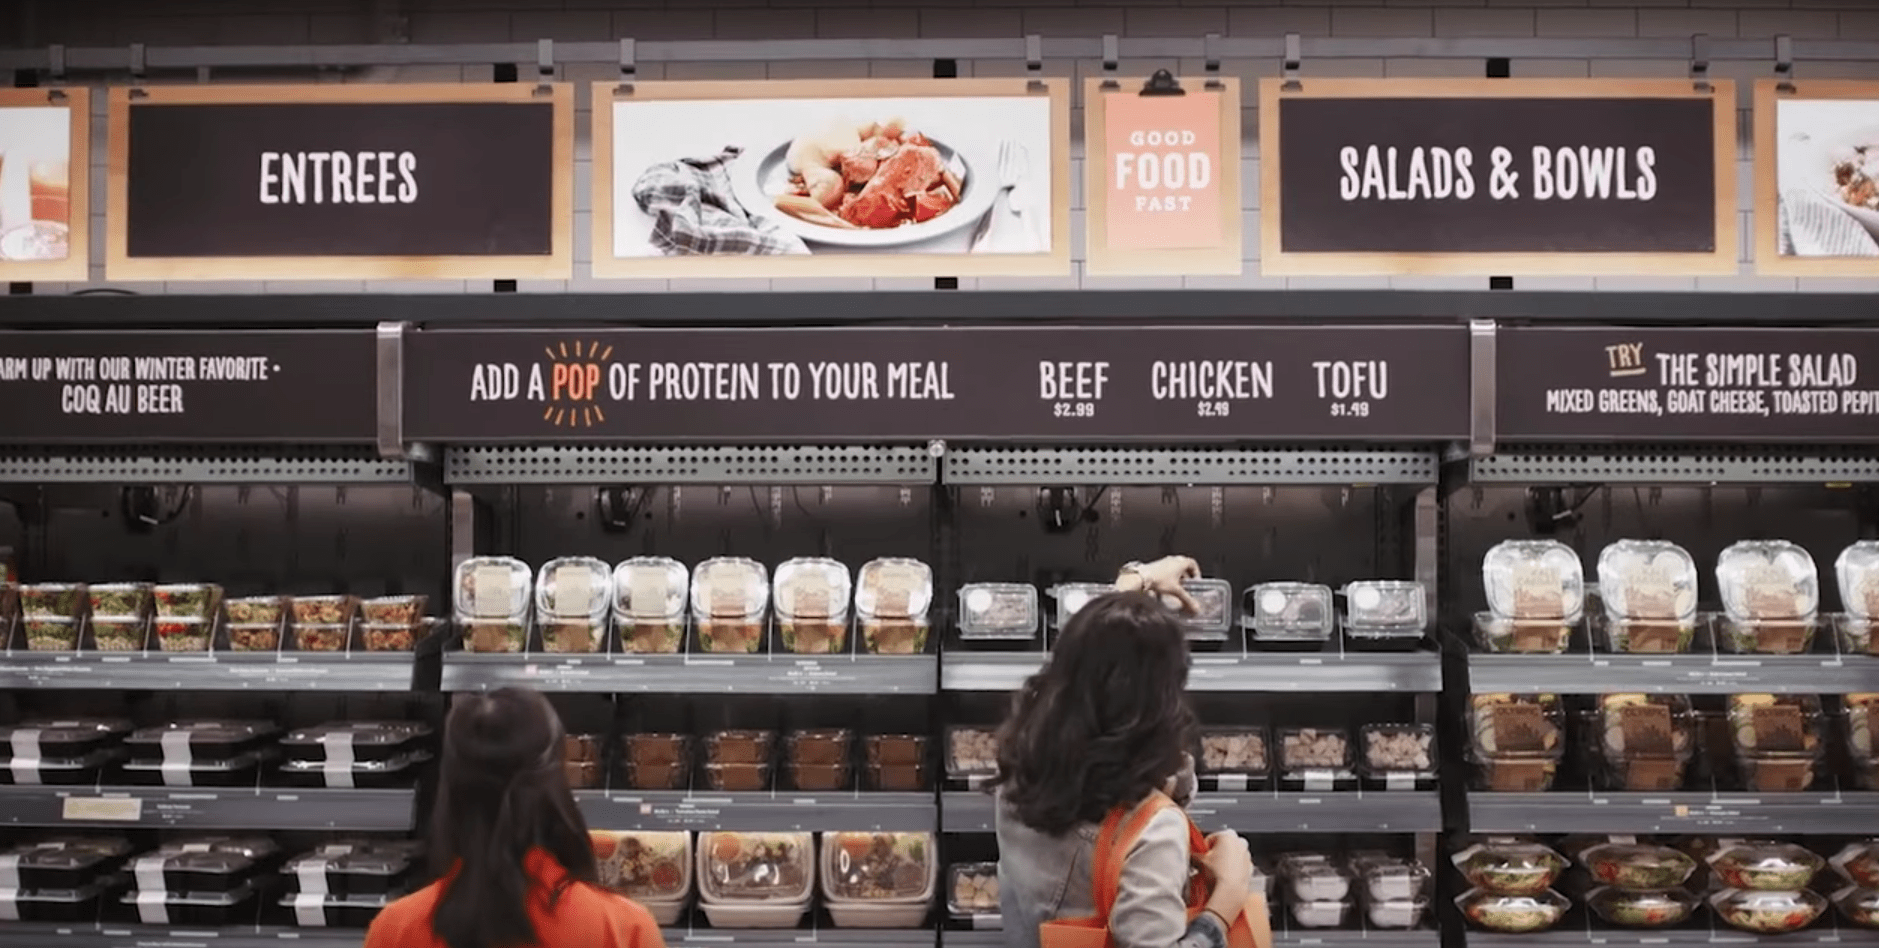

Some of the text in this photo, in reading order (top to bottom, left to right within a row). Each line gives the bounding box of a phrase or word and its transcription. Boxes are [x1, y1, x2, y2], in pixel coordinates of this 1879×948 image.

[1130, 130, 1196, 146] GOOD
[259, 150, 418, 204] ENTREES
[1116, 152, 1211, 190] FOOD
[1340, 145, 1657, 200] SALADS & BOWLS
[1135, 196, 1192, 212] FAST
[32, 357, 52, 380] UP
[56, 357, 96, 380] WITH
[99, 357, 131, 380] OUR
[135, 357, 197, 380] WINTER
[200, 356, 268, 380] FAVORITE
[1605, 342, 1645, 369] TRY
[471, 361, 956, 401] ADD A POP OF PROTEIN TO YOUR MEAL
[1039, 360, 1388, 399] BEEF CHICKEN TOFU
[1656, 353, 1857, 387] THE SIMPLE SALAD
[62, 384, 184, 414] COQ AU BEER
[1054, 402, 1095, 417] $2.99
[1198, 401, 1230, 416] $2.49
[1331, 402, 1370, 417] $1.49
[1546, 389, 1595, 414] MIXED
[1598, 389, 1663, 417] GREENS,
[1667, 389, 1707, 414] GOAT
[1710, 390, 1770, 417] CHEESE,
[1772, 390, 1839, 414] TOASTED
